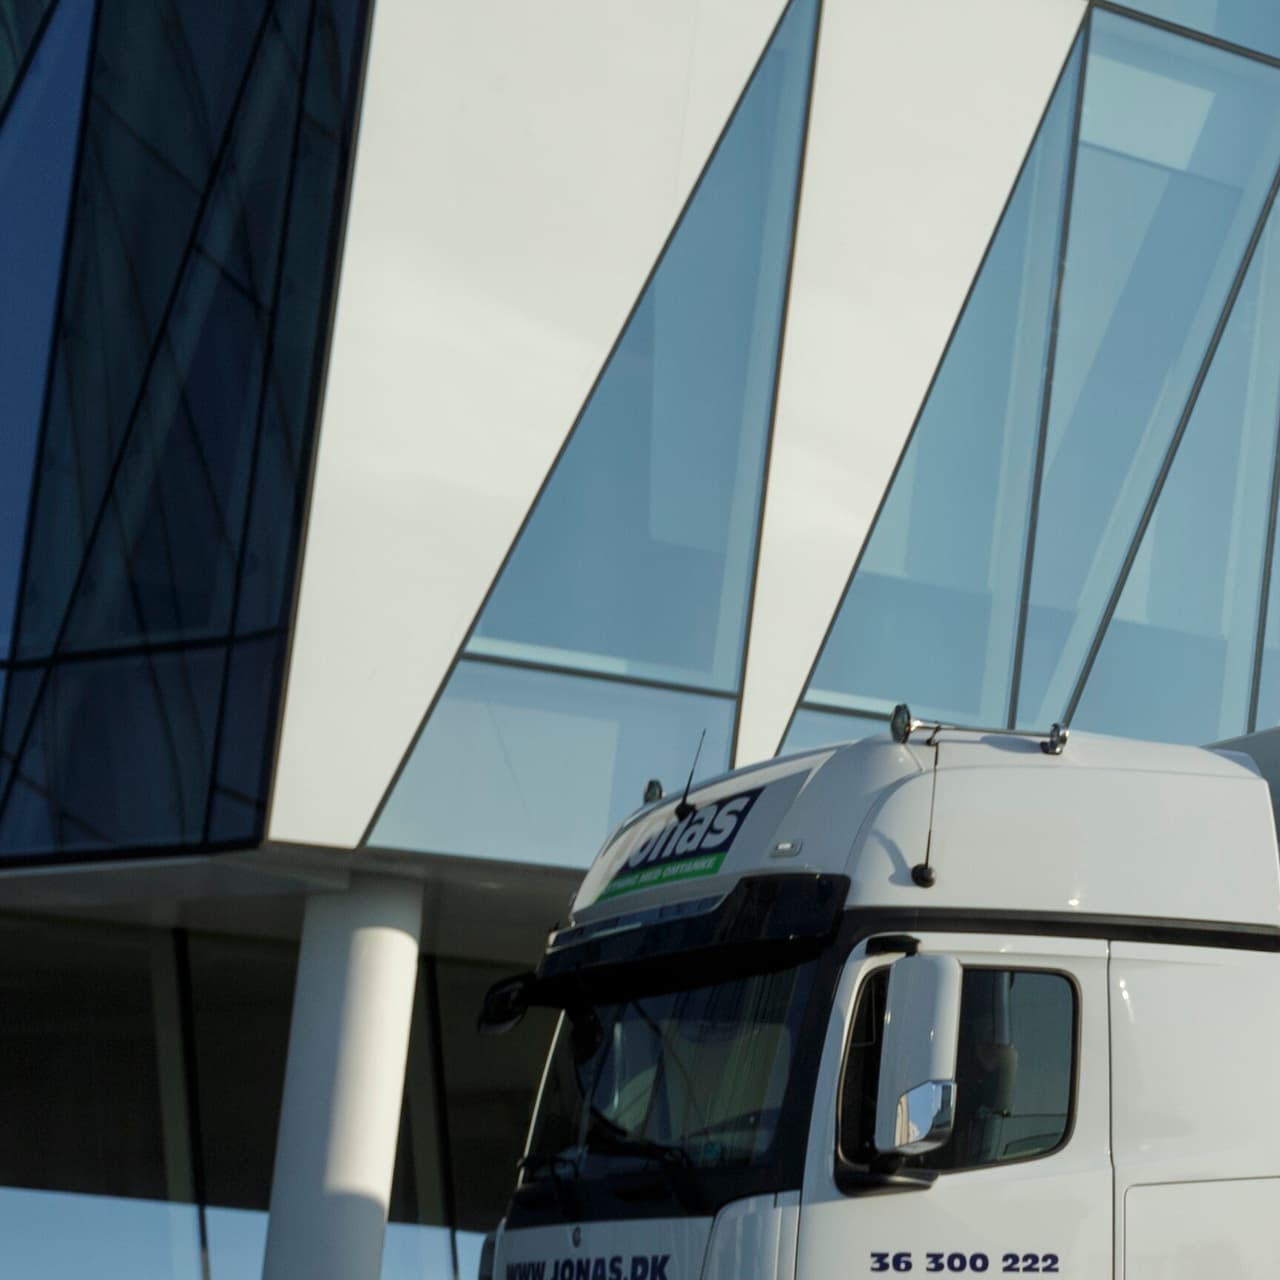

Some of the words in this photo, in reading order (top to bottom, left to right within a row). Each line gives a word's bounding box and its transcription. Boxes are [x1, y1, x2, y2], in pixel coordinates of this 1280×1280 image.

[870, 1252, 913, 1273] 36
[926, 1252, 989, 1273] 300
[1002, 1253, 1060, 1273] 222
